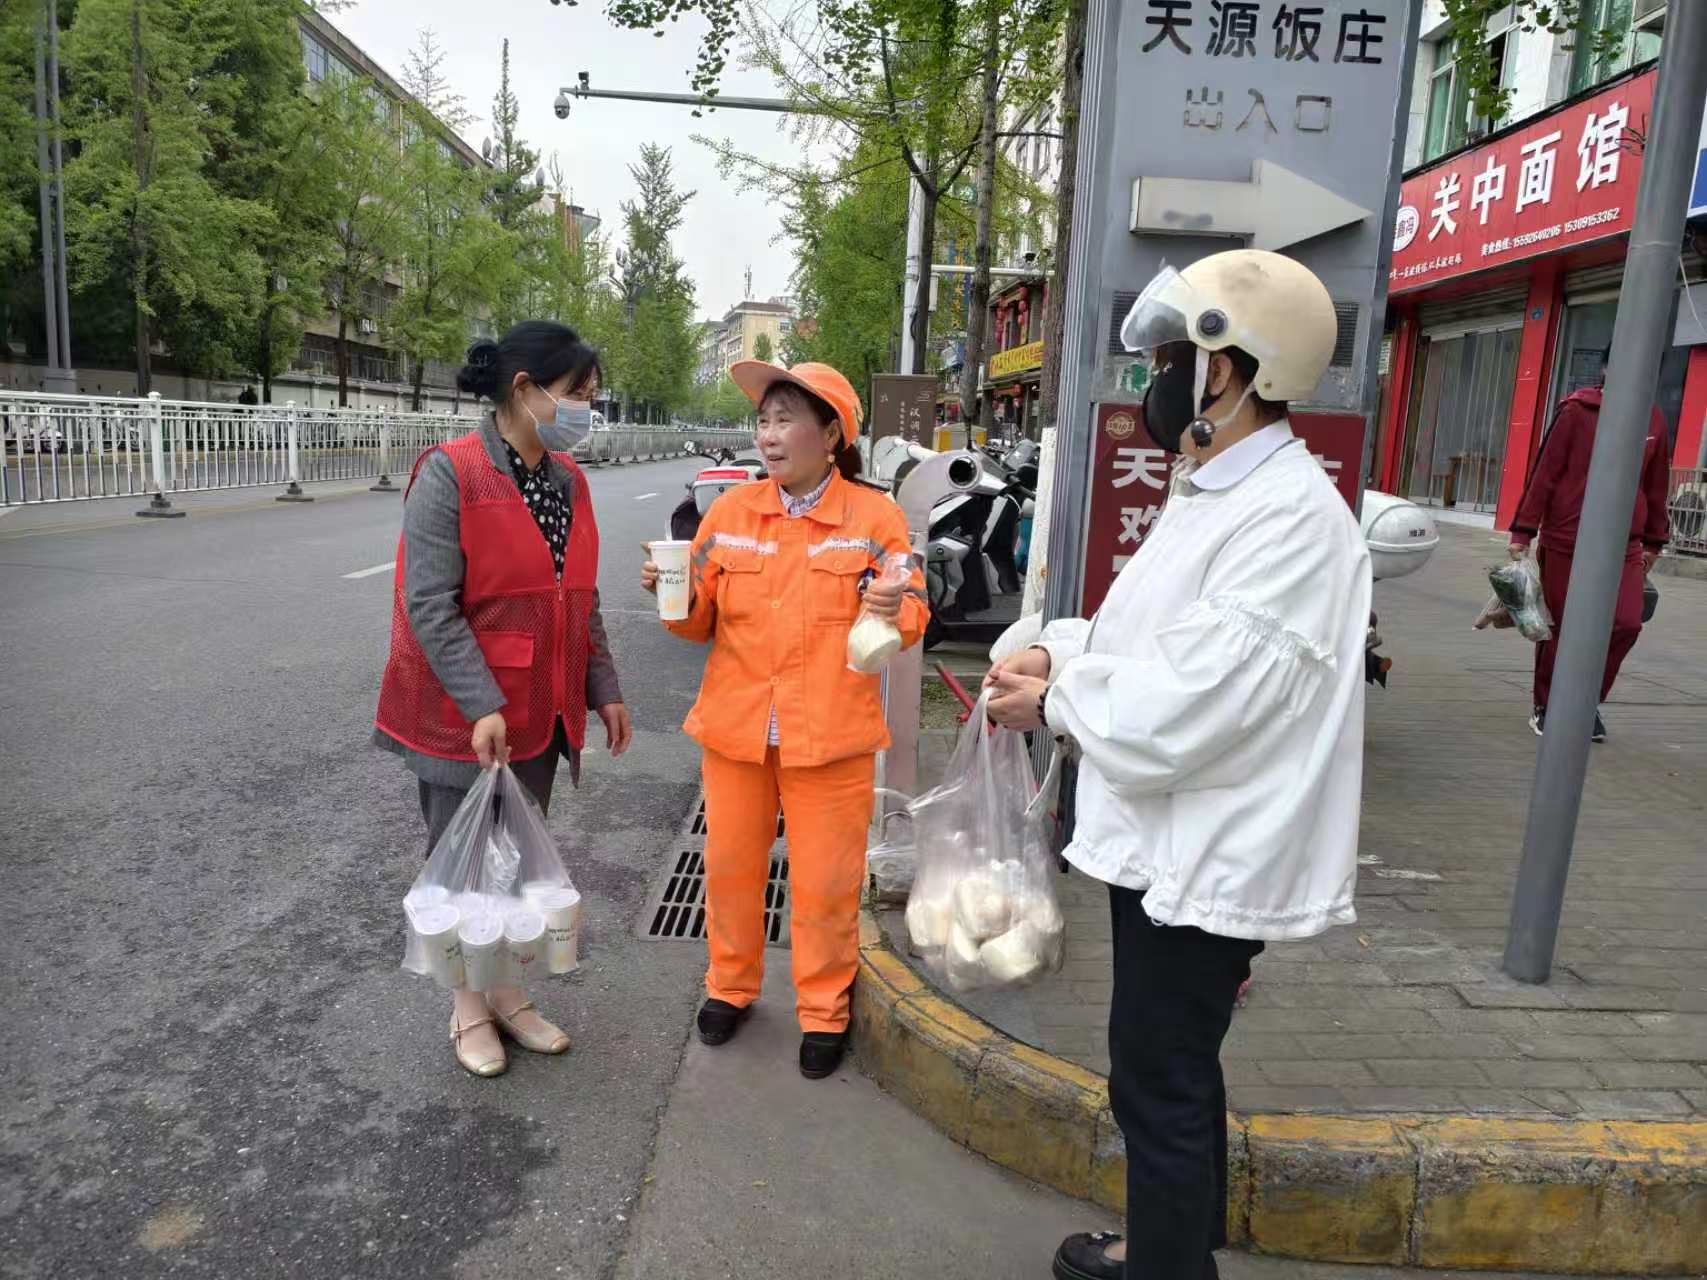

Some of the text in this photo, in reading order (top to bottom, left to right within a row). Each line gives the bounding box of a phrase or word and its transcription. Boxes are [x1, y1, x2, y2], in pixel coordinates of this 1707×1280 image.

[1141, 0, 1387, 64] 天源饭庄
[1184, 86, 1332, 134] 出入口
[1427, 101, 1630, 242] 关中面馆
